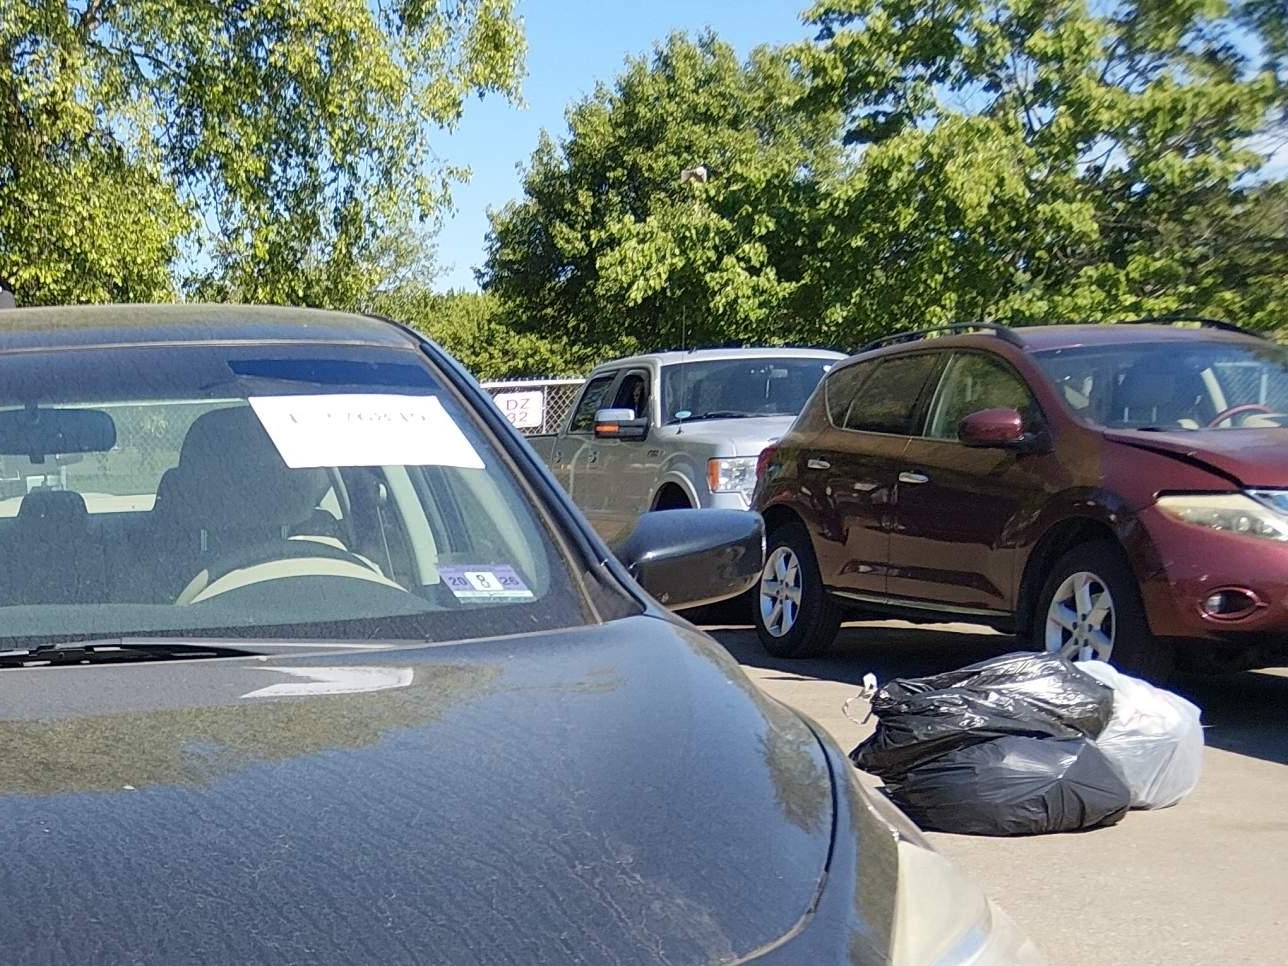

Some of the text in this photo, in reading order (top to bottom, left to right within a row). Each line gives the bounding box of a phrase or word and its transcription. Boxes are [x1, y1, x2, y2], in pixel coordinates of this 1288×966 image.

[507, 398, 530, 411] DZ
[448, 576, 468, 586] 20
[476, 574, 490, 588] 8
